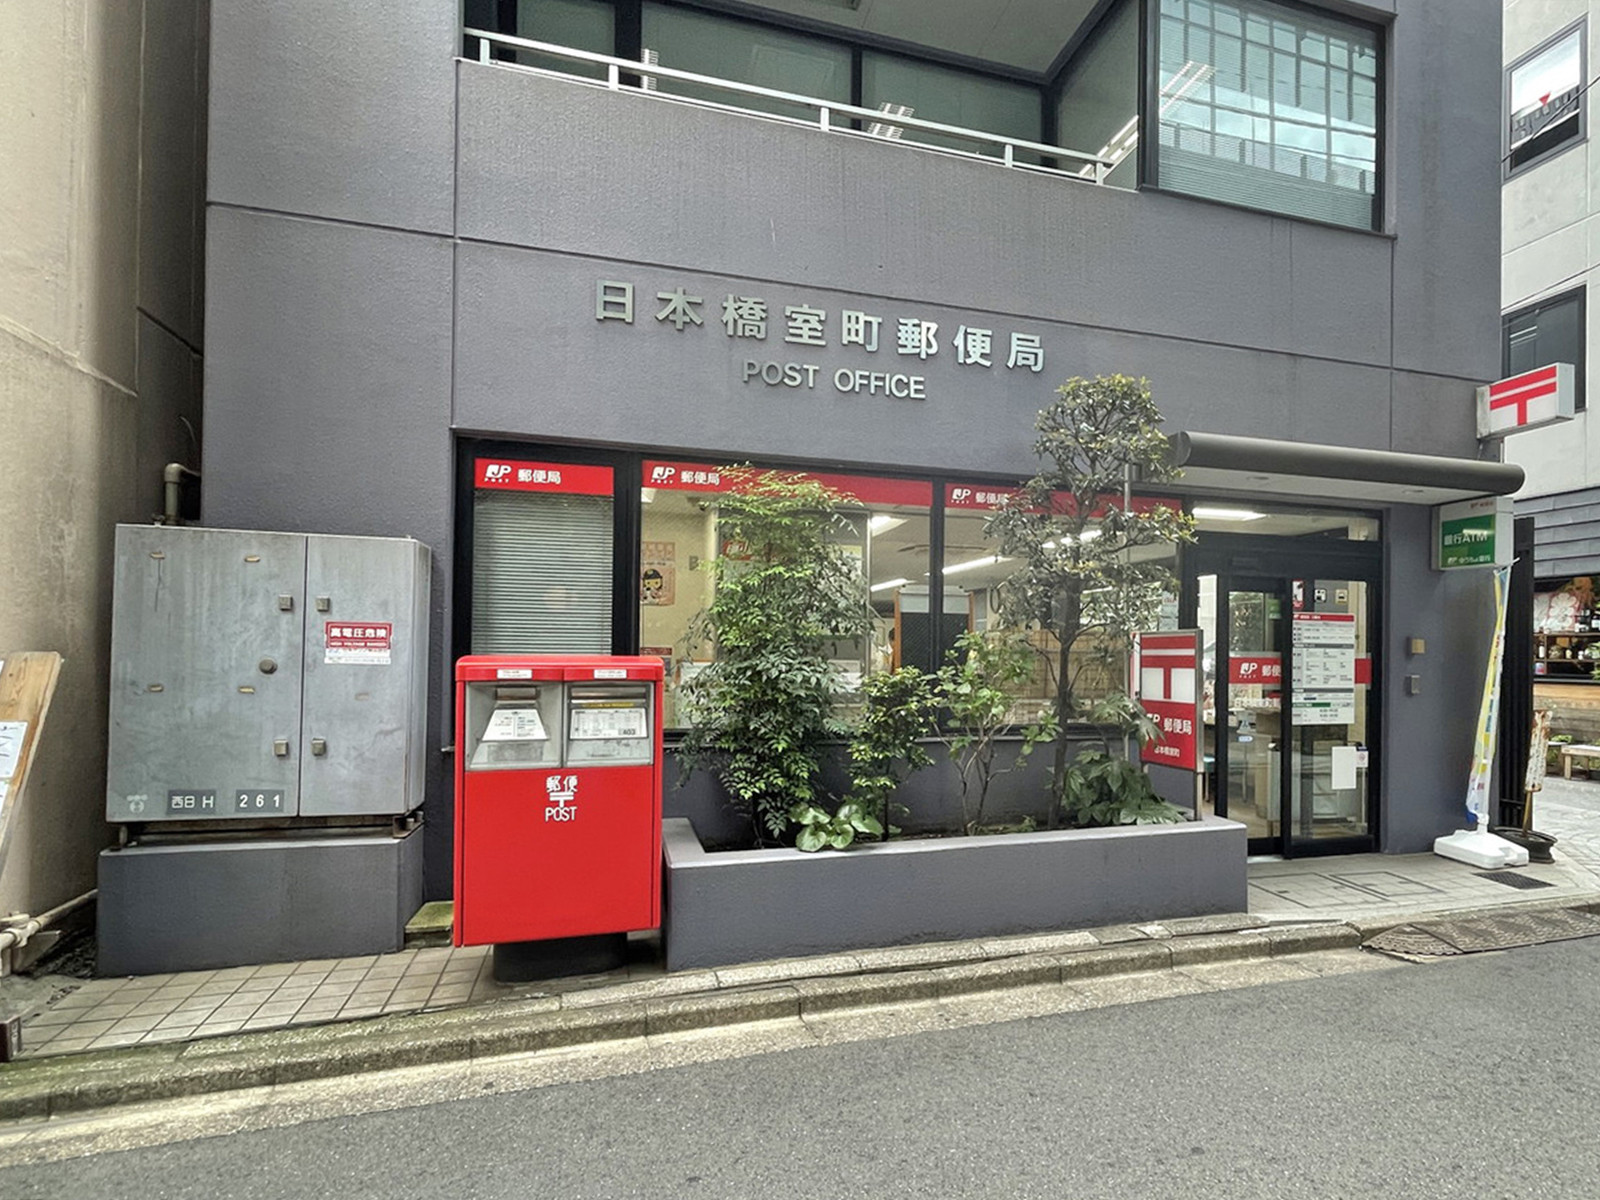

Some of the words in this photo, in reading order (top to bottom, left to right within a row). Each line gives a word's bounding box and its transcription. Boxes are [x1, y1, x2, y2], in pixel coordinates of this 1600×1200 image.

[596, 279, 1045, 372] 日本橋室町郵便局
[743, 360, 820, 388] POST
[834, 368, 926, 399] OFFICE
[518, 468, 561, 484] 郵便局
[681, 470, 720, 486] 郵便局
[1164, 717, 1192, 735] 郵便局
[546, 775, 578, 792] 郵便
[202, 795, 214, 808] H
[239, 794, 280, 808] 261
[545, 806, 578, 822] POST
